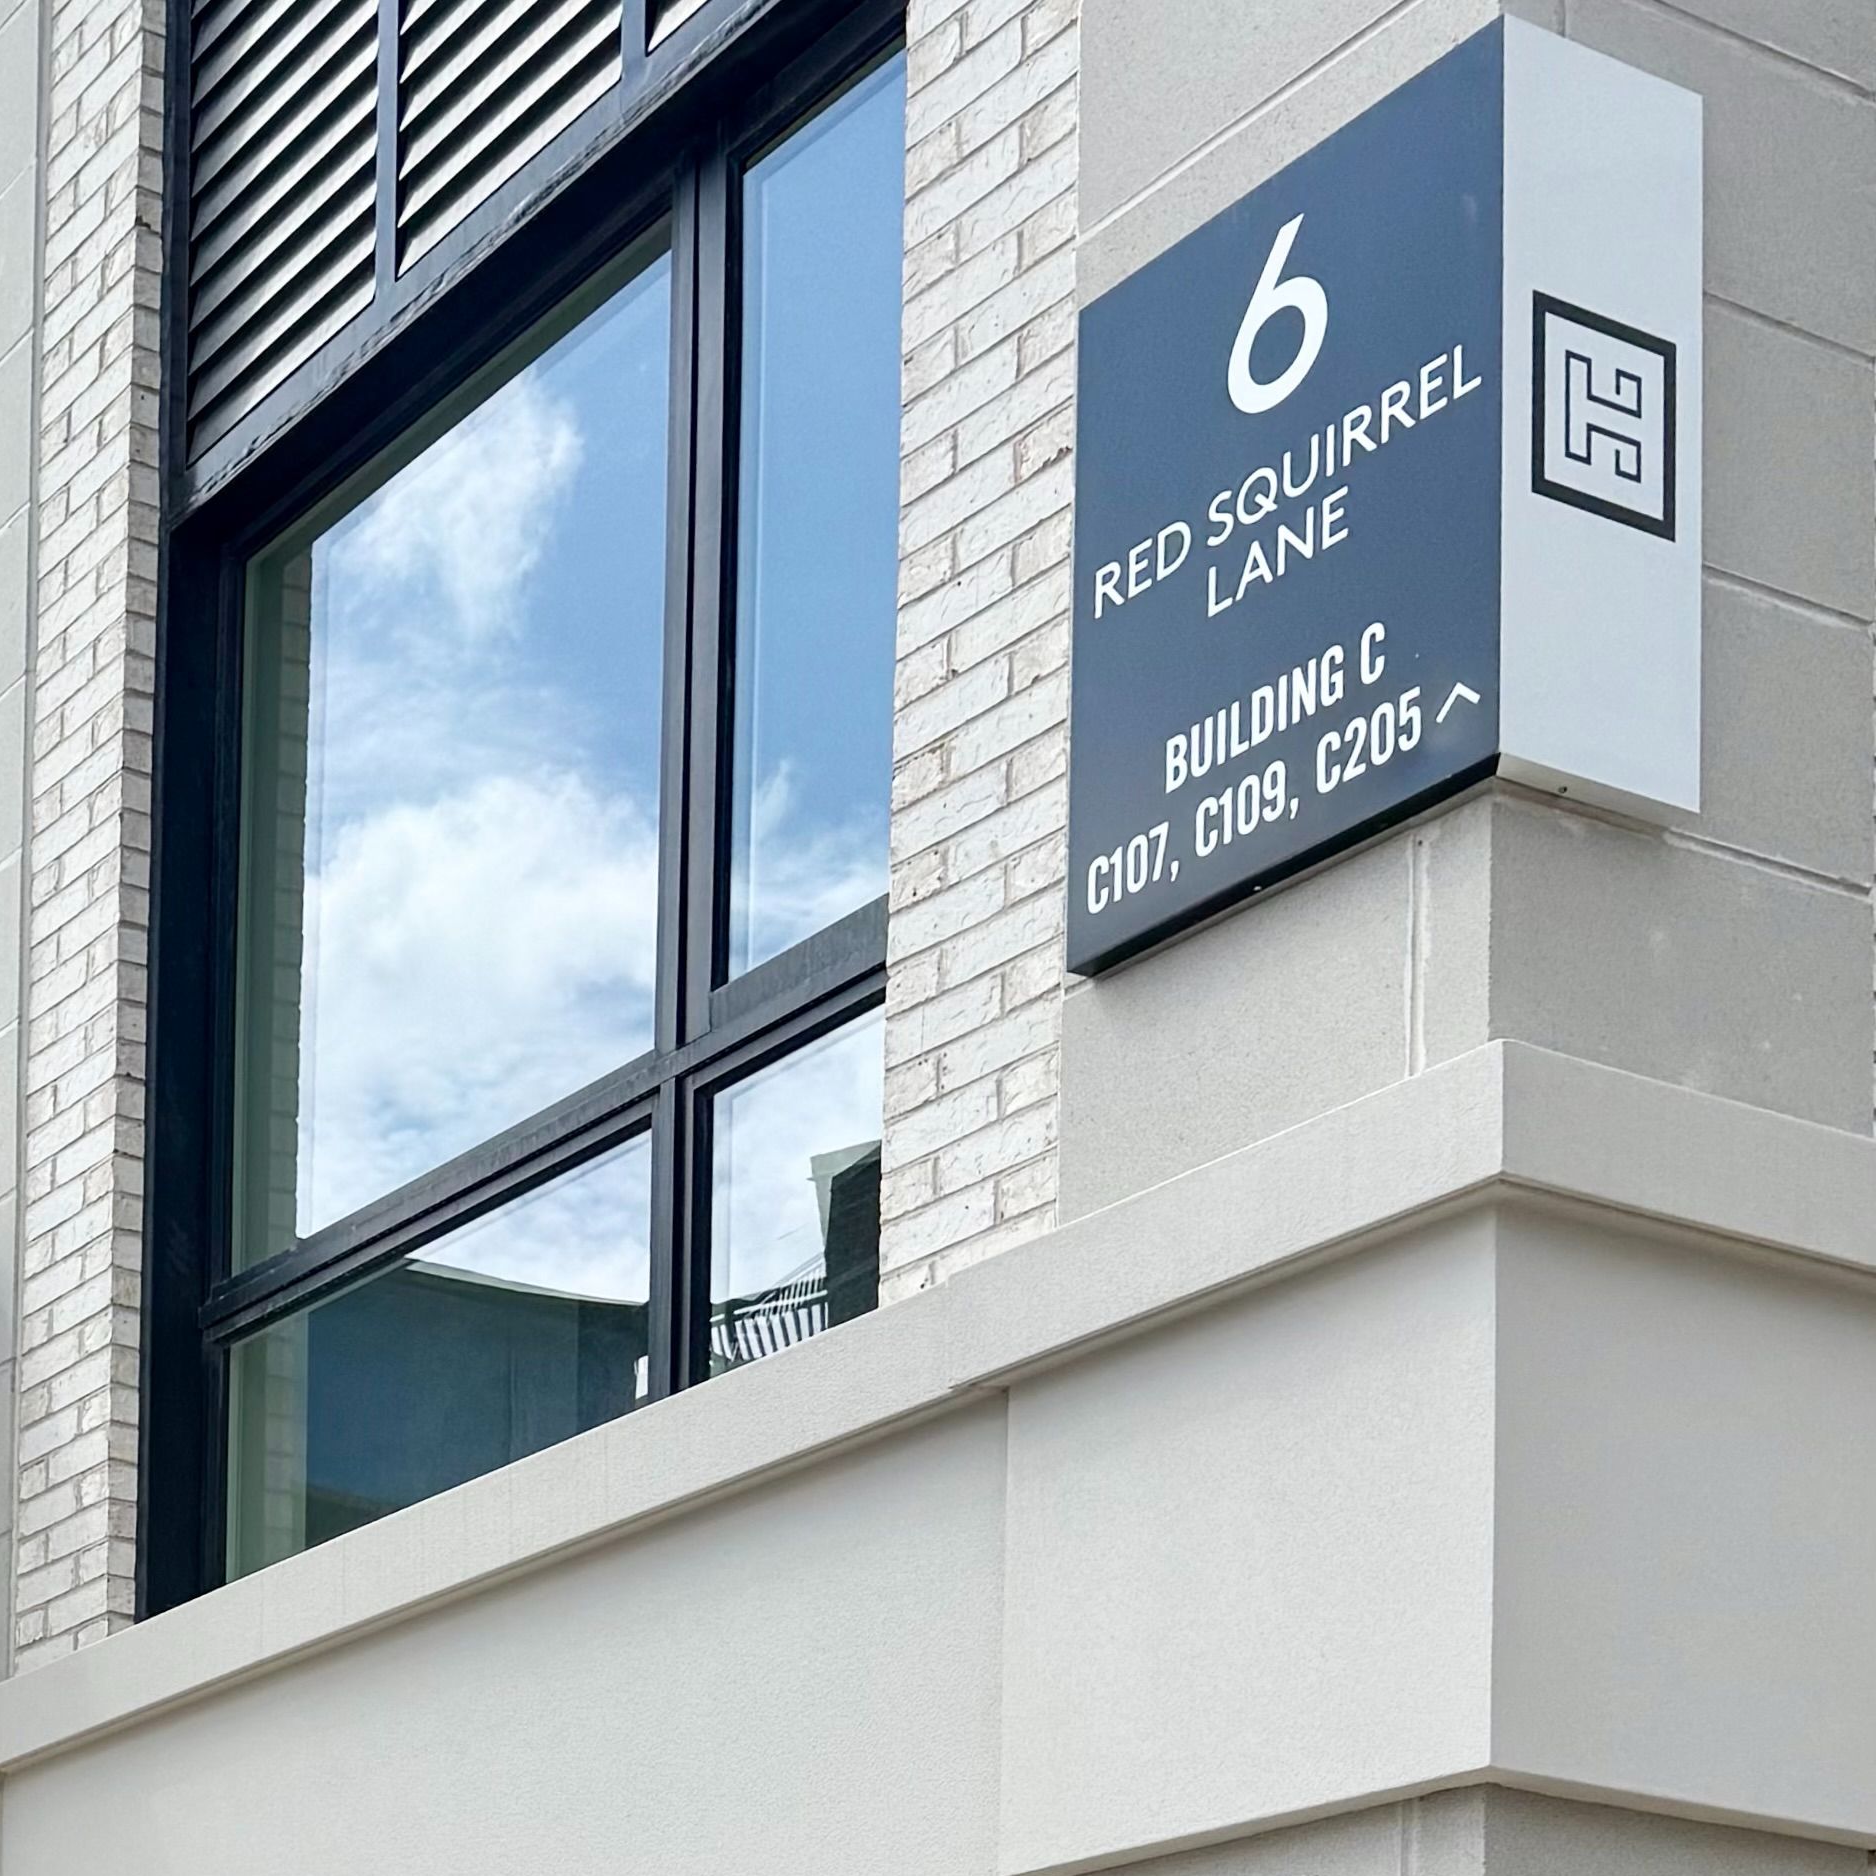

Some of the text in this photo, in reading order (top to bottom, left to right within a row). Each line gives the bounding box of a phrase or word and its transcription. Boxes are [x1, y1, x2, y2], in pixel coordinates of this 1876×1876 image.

[1226, 211, 1329, 415] 6
[1092, 343, 1483, 620] RED SQUIRREL
[1206, 484, 1350, 619] LANE
[1086, 685, 1423, 916] C107, C109, C205
[1164, 621, 1387, 796] BUILDING C
